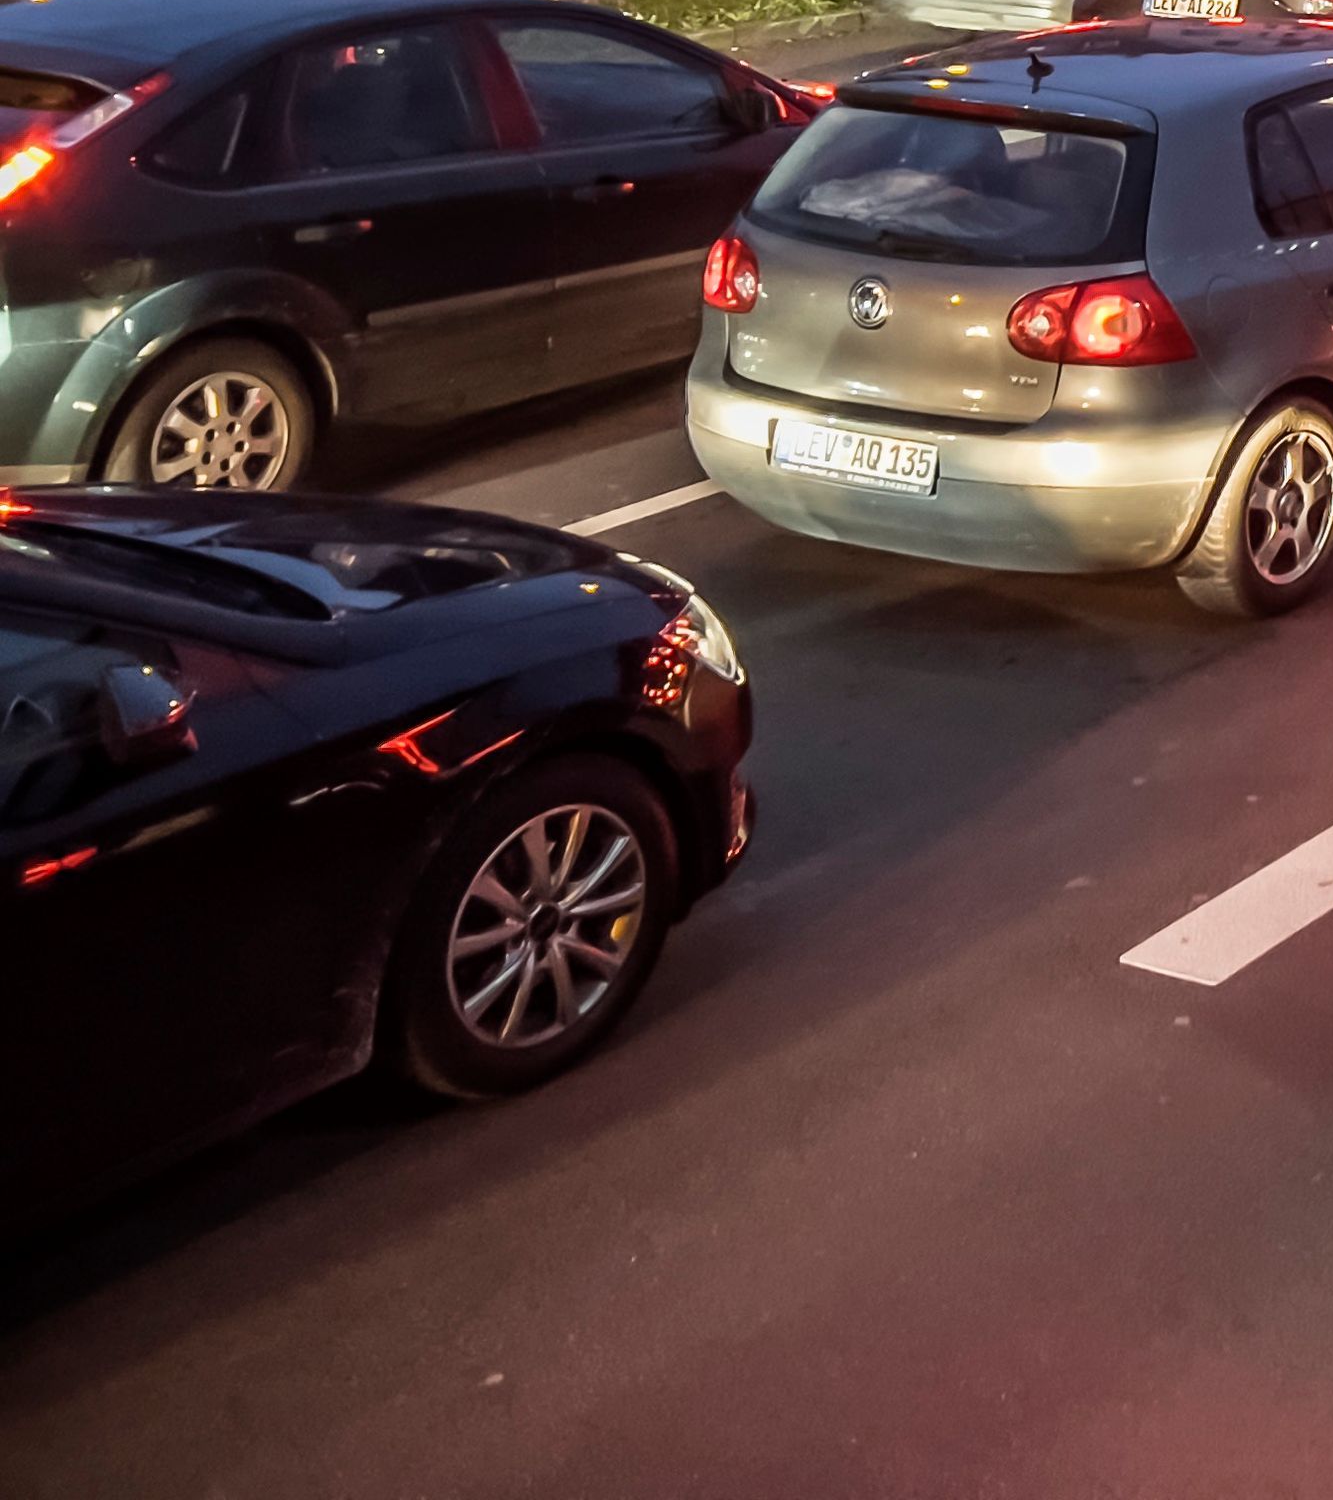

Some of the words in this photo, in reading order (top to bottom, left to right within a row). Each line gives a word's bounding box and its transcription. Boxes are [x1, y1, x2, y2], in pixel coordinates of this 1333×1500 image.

[1206, 0, 1232, 18] 226
[793, 430, 839, 462] LEV
[850, 437, 883, 471] AQ
[886, 444, 933, 479] 135
